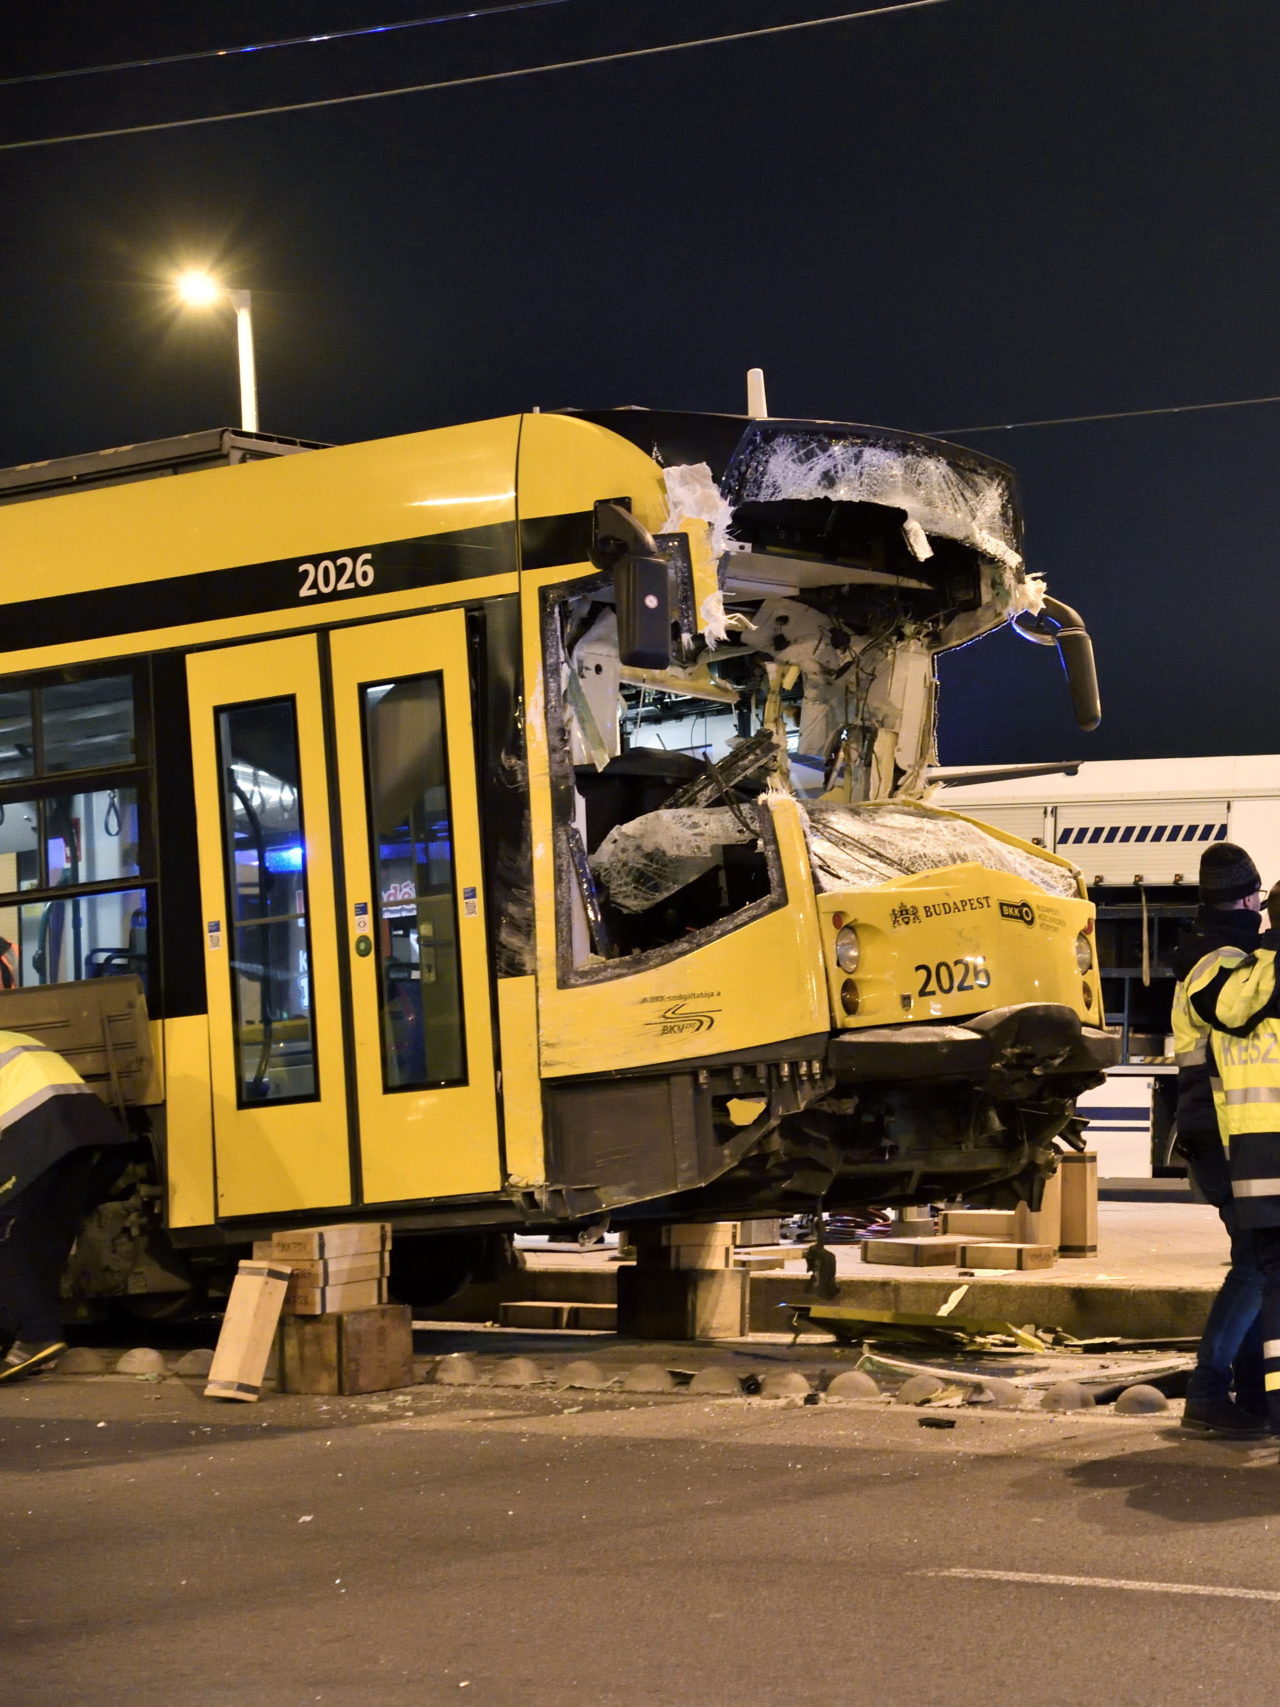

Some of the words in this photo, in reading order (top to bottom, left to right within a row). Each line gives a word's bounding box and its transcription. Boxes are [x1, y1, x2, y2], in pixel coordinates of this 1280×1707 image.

[298, 552, 375, 597] 2026
[923, 896, 992, 918] BUDAPEST
[1002, 905, 1020, 917] BKK
[914, 956, 991, 998] 2026
